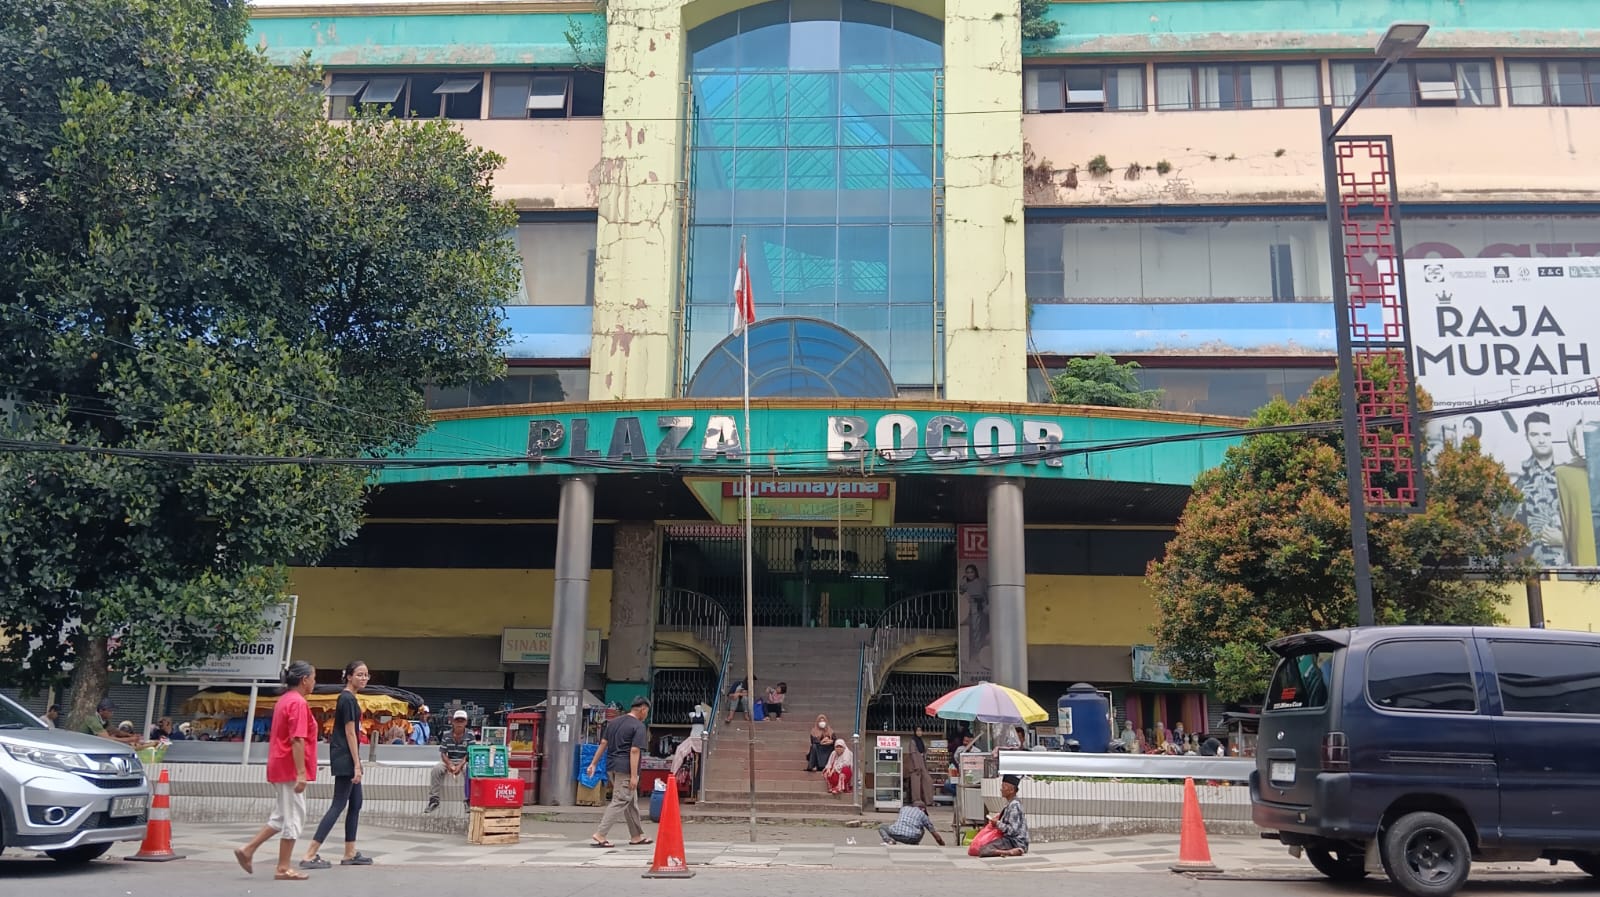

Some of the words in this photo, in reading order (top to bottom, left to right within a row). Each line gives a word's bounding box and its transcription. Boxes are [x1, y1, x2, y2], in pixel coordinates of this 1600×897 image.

[1436, 305, 1566, 337] RAJA
[1416, 343, 1591, 376] MURAH
[1510, 378, 1593, 394] Fashion
[527, 415, 744, 461] PLAZA
[827, 414, 1064, 469] BOGOR
[231, 643, 274, 655] BOGOR
[506, 640, 548, 652] SINAR
